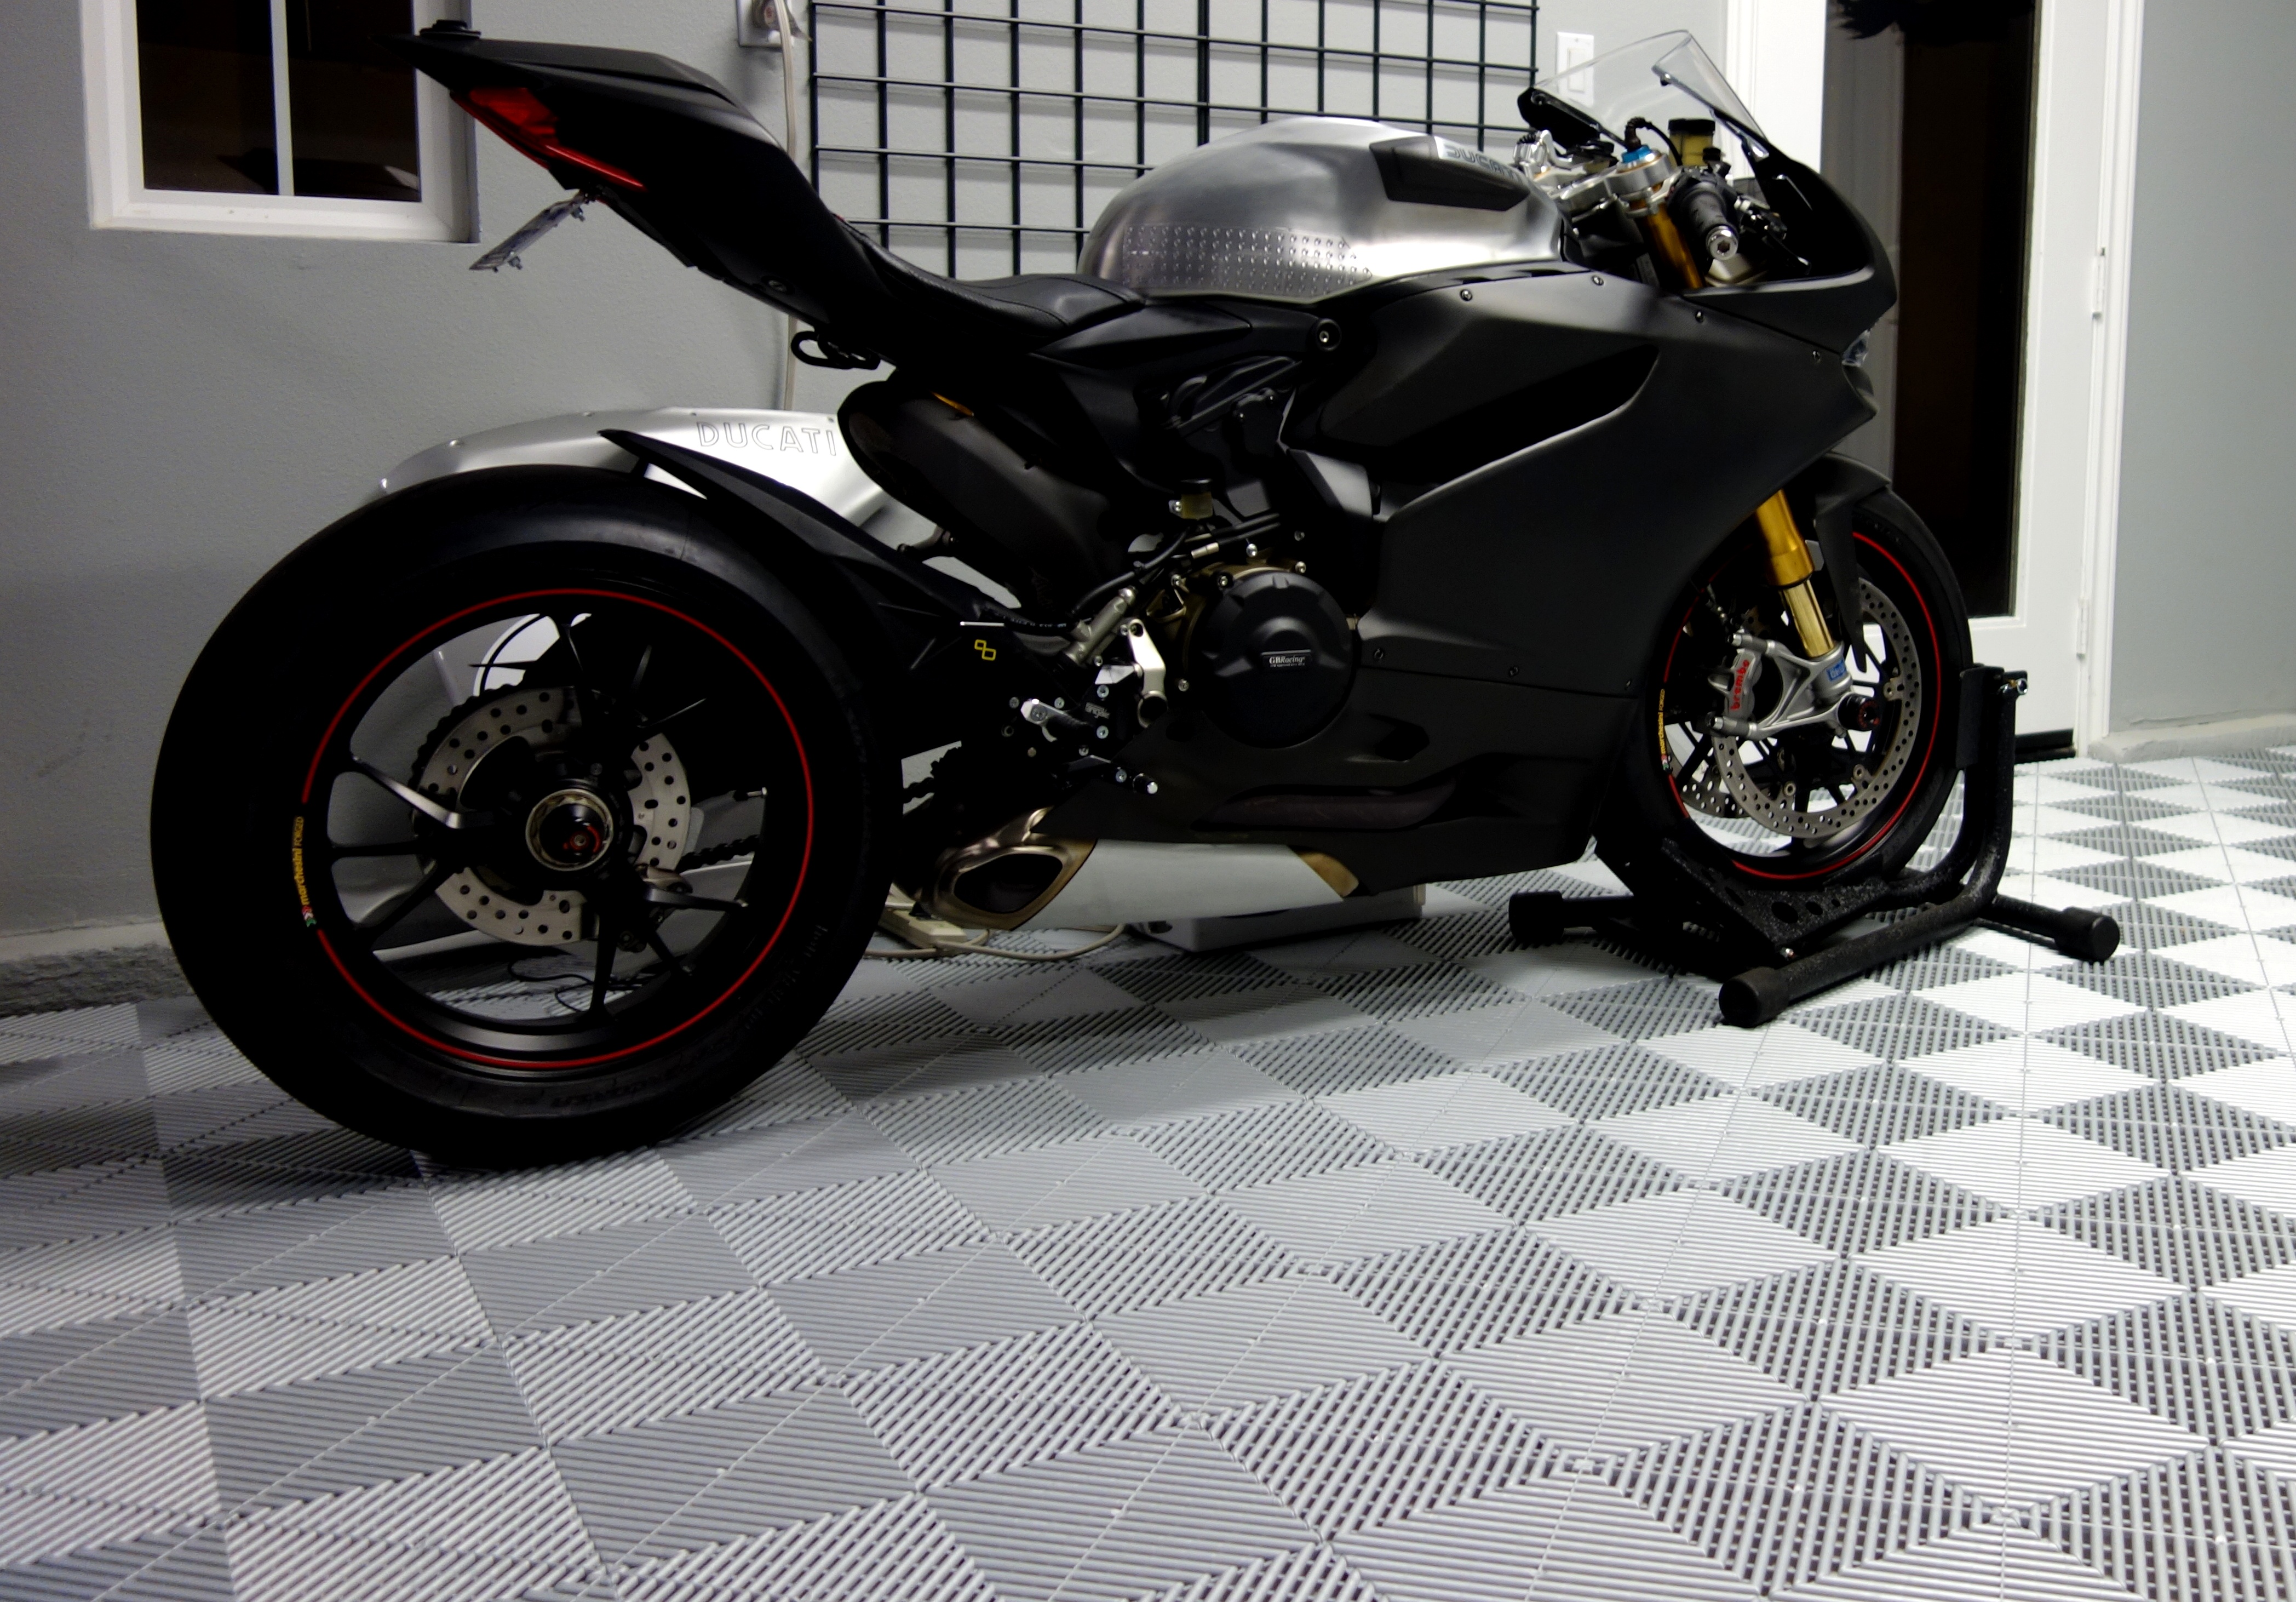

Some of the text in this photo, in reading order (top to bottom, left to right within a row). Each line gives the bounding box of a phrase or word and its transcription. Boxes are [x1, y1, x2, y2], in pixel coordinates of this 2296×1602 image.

[696, 421, 836, 456] DUCATI
[1730, 660, 1749, 710] brembo
[292, 848, 310, 906] marchesini
